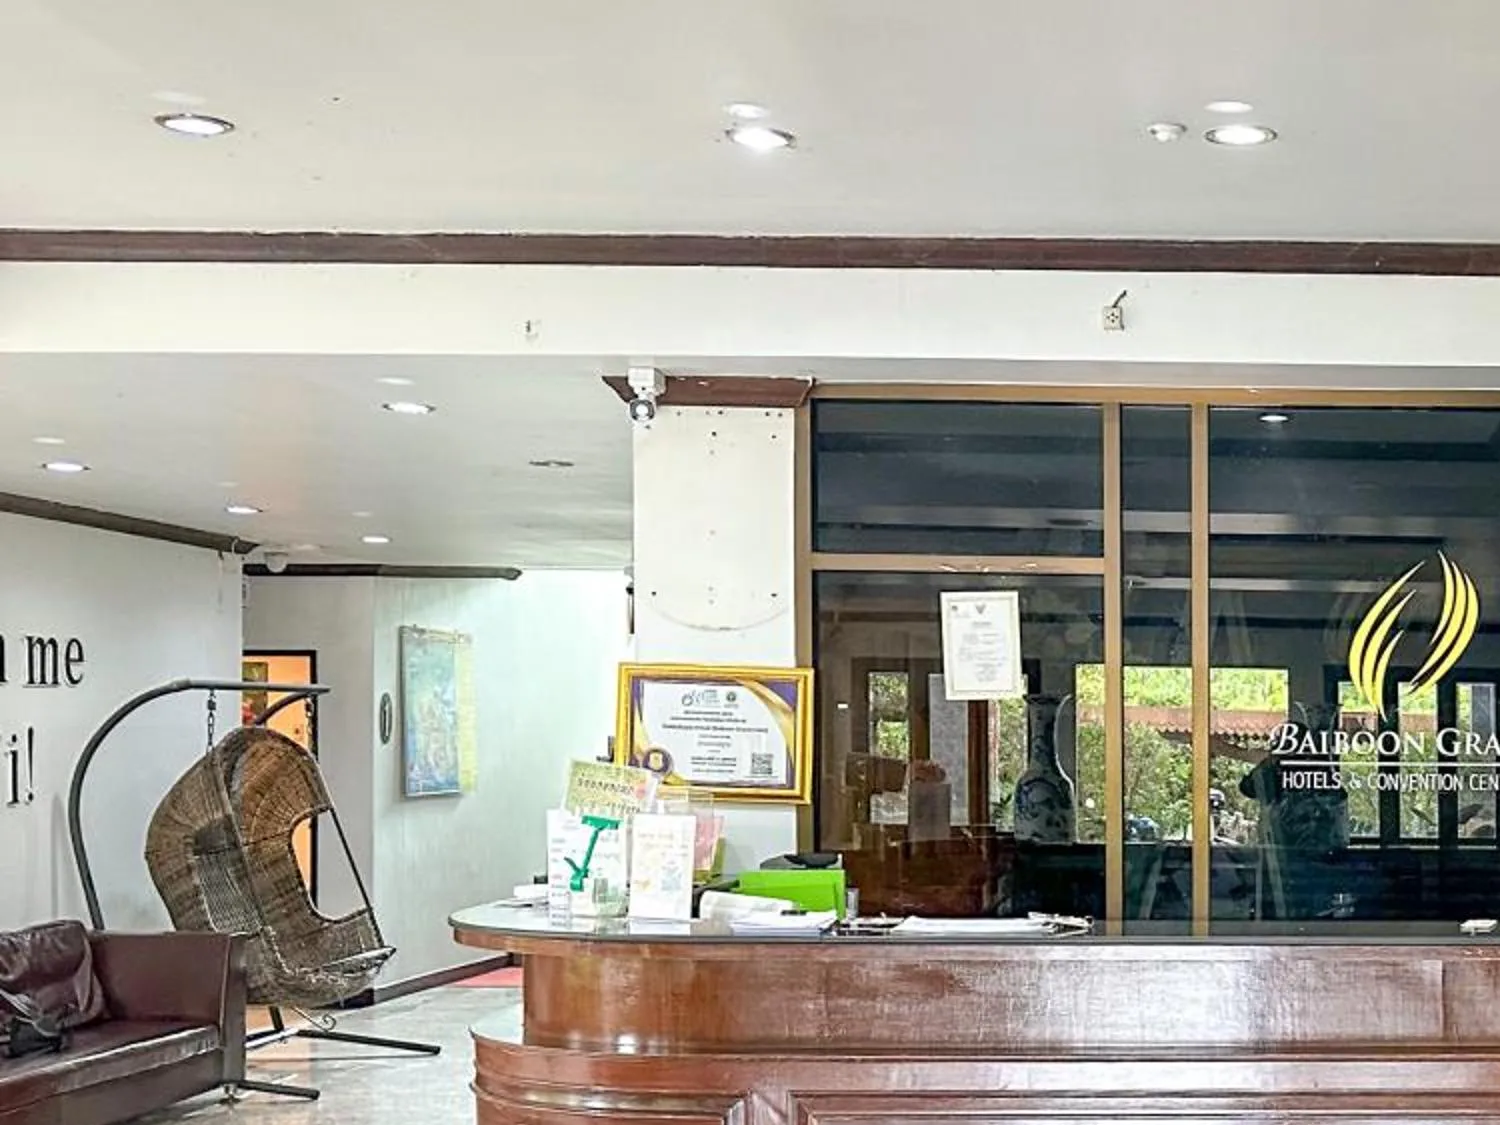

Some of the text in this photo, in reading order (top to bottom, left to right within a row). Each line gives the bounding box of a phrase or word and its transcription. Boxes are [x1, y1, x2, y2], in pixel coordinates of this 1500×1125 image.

[25, 635, 85, 685] me
[1282, 771, 1341, 790] HOTELS
[1349, 772, 1361, 790] &
[1367, 772, 1463, 791] CONVENTION
